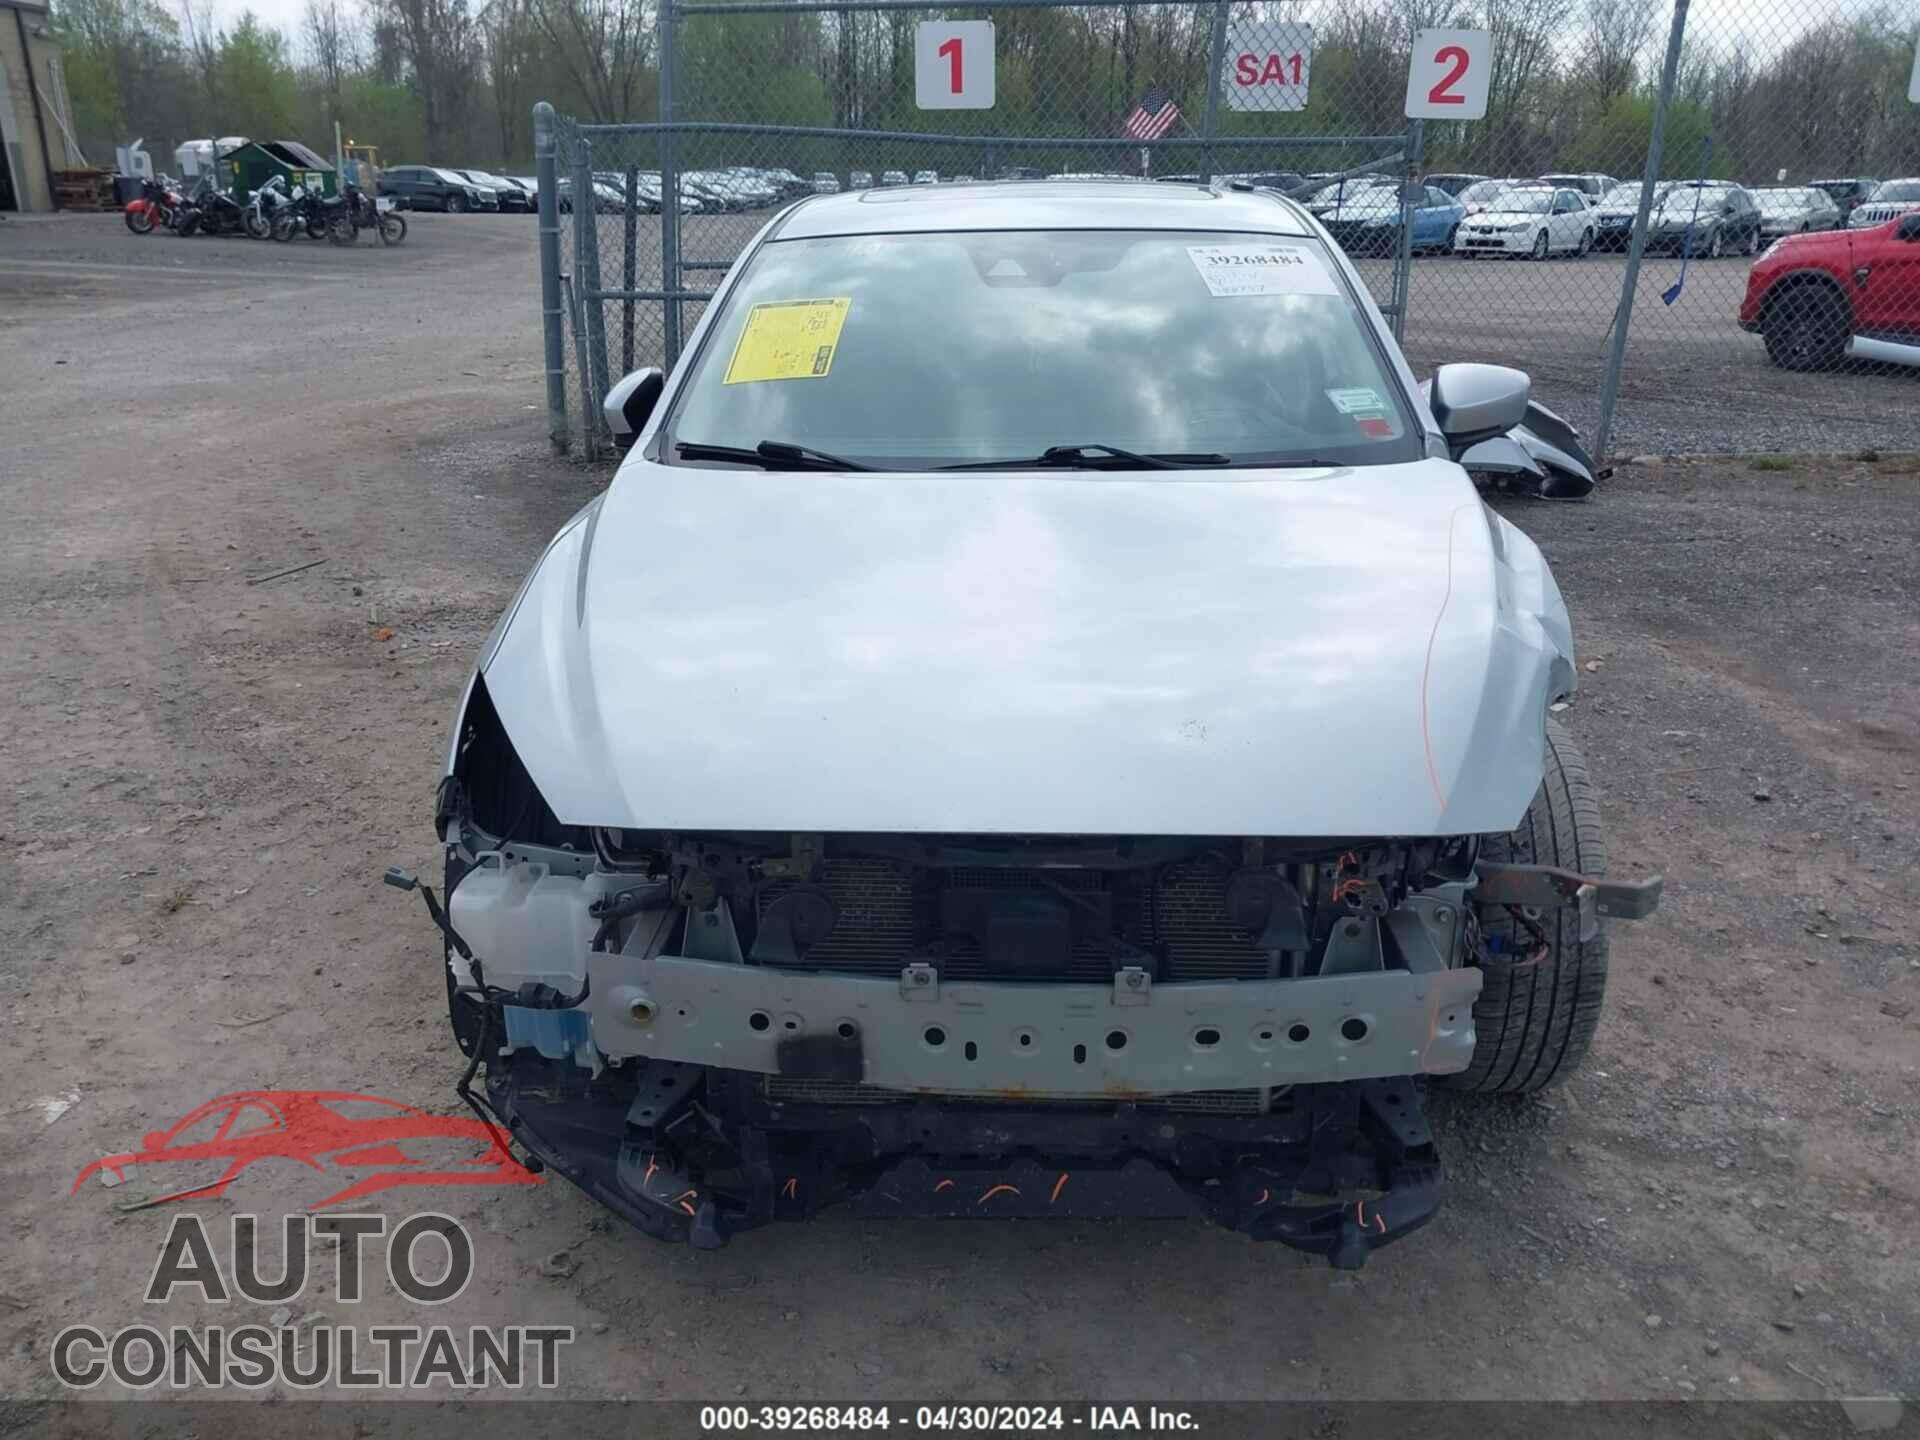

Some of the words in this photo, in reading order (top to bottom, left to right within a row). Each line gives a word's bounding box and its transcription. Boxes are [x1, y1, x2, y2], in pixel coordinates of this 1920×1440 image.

[938, 38, 963, 94] 1
[1236, 54, 1302, 86] SA1
[1428, 46, 1470, 104] 2
[1207, 255, 1304, 266] 39268484
